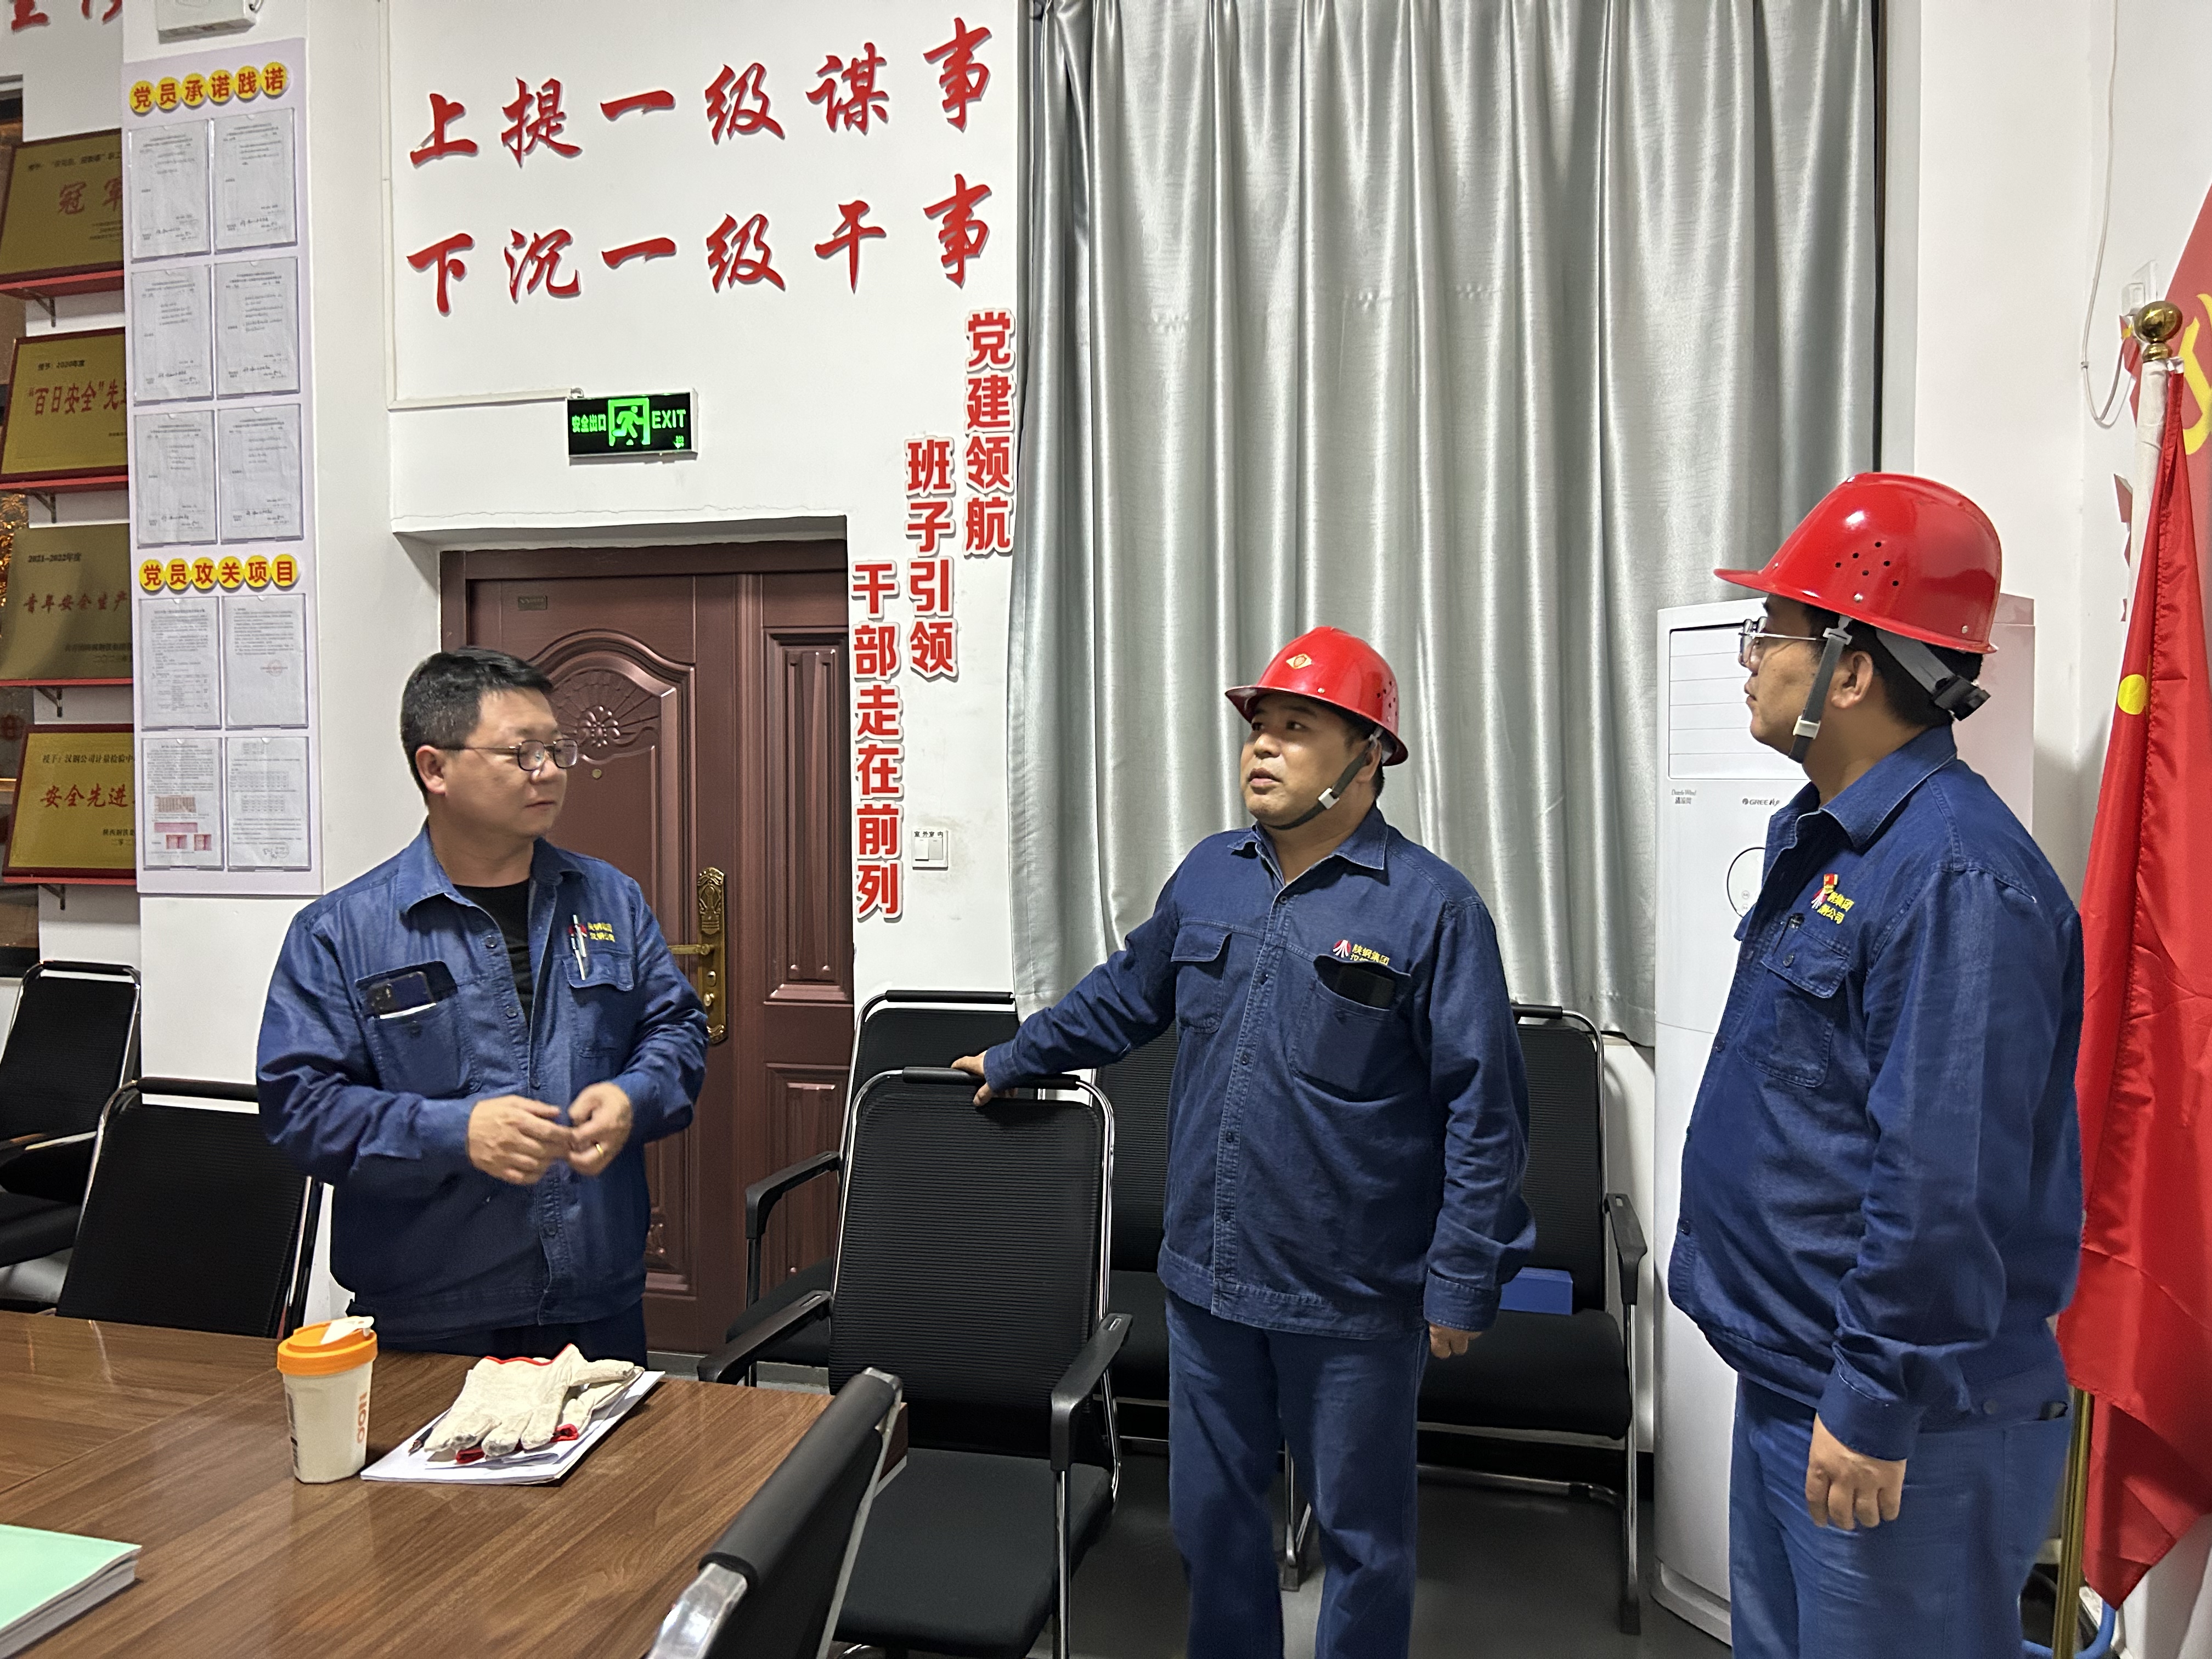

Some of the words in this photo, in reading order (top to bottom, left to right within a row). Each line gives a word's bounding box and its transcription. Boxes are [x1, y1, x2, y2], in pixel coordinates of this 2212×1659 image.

[133, 66, 284, 110] 党员承诺践诺
[409, 16, 993, 168] 上提一级谋事
[405, 173, 993, 315] 下沉一级干事
[29, 379, 126, 415] “百日安全”先
[651, 409, 686, 428] EXIT
[572, 414, 606, 432] 安全出口
[966, 311, 1011, 551] 党建领航
[143, 561, 294, 586] 党员攻关项目
[908, 439, 953, 674] 班子引领
[853, 563, 899, 916] 干部走在前列
[40, 783, 135, 808] 安全先进
